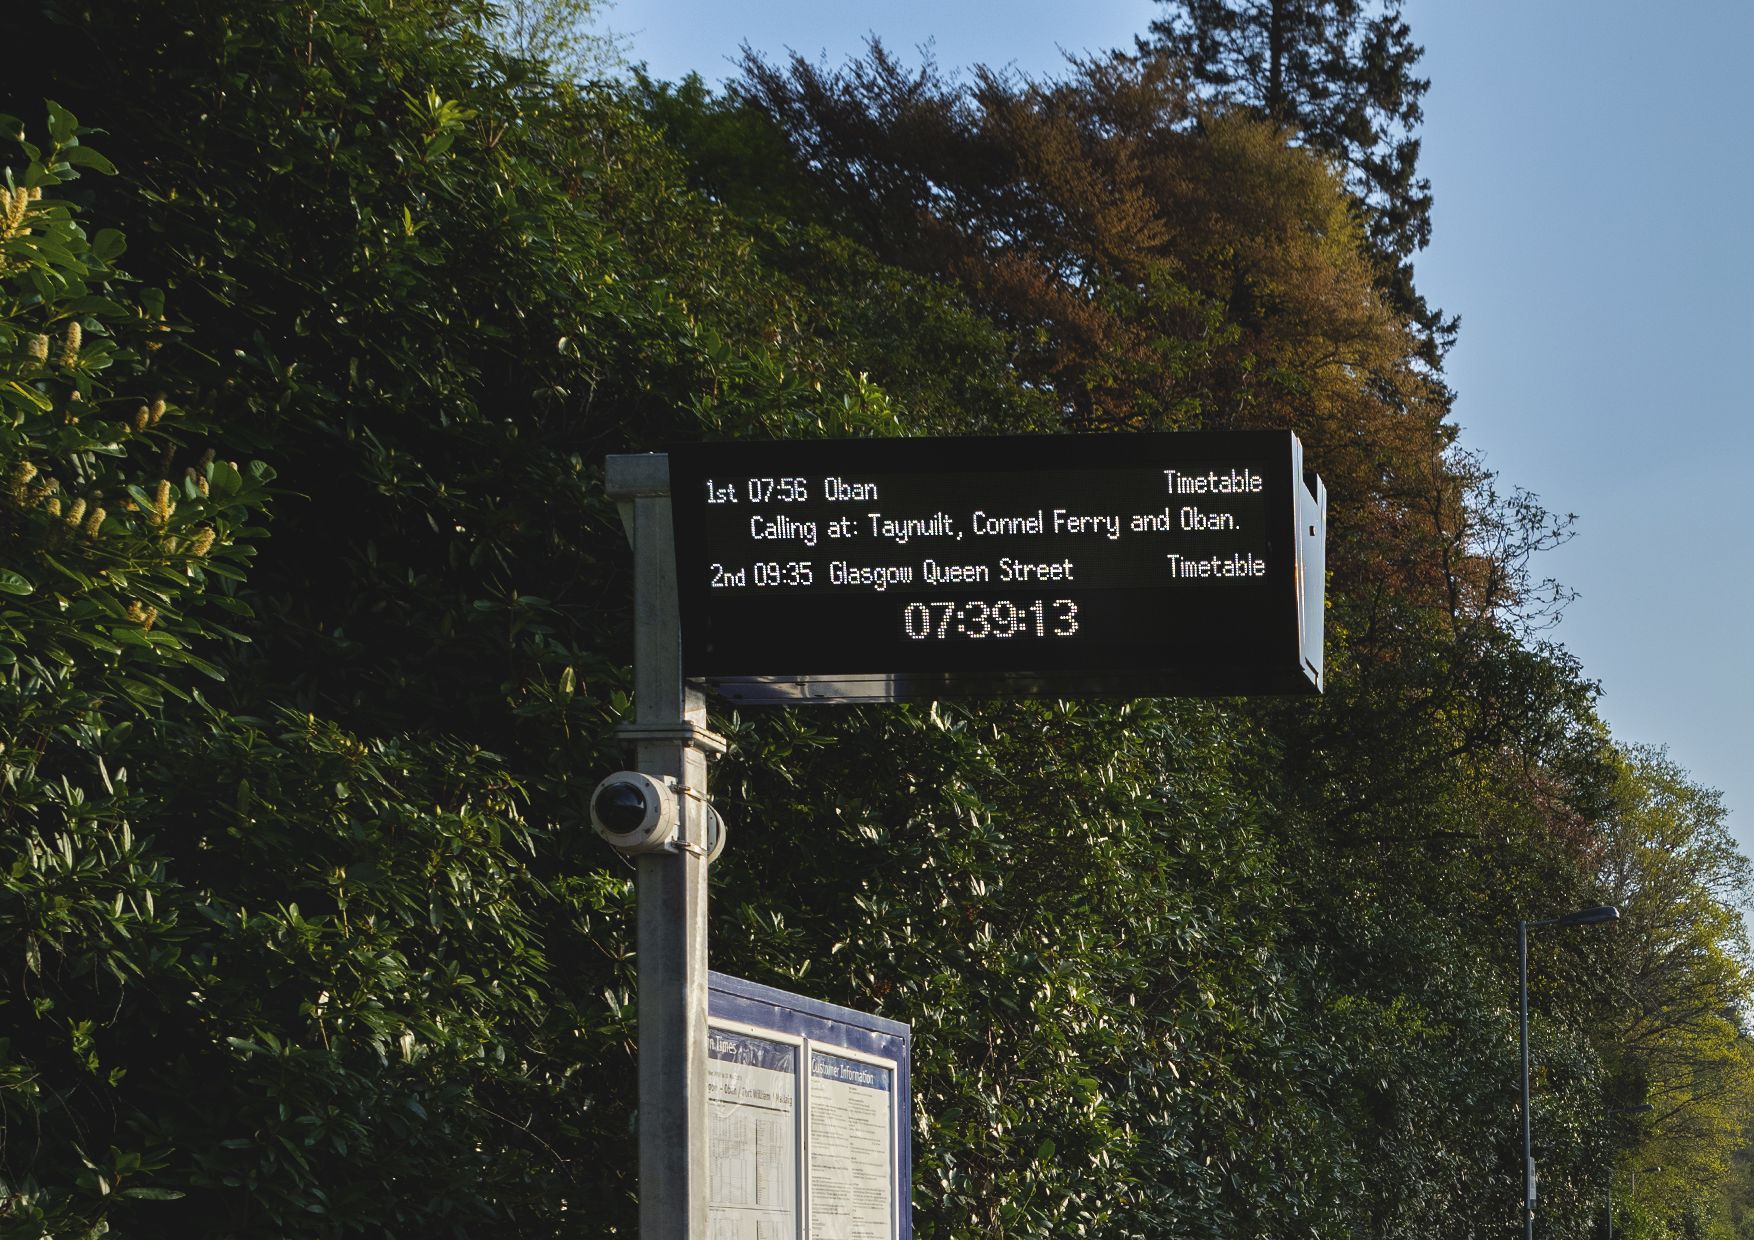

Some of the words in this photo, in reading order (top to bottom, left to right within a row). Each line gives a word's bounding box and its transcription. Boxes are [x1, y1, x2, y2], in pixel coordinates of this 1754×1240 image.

[706, 479, 738, 504] 1st
[748, 477, 808, 503] 07:56
[824, 476, 878, 502] Oban
[1163, 468, 1263, 494] Timetable
[750, 514, 818, 547] Calling
[827, 516, 858, 538] at:
[867, 511, 963, 544] Taynuilt,
[972, 509, 1044, 535] Connel
[1053, 509, 1120, 540] Ferry
[1130, 507, 1170, 532] and
[1180, 506, 1240, 531] Oban.
[710, 562, 746, 588] 2nd
[753, 561, 814, 587] 09:35
[829, 560, 913, 592] Glasgow
[922, 559, 989, 586] Queen
[999, 557, 1074, 582] Street
[1166, 552, 1266, 578] Timetable
[904, 599, 1079, 640] 07:39:13
[716, 1034, 737, 1055] Times
[811, 1058, 840, 1078] Customer
[840, 1064, 874, 1085] Information
